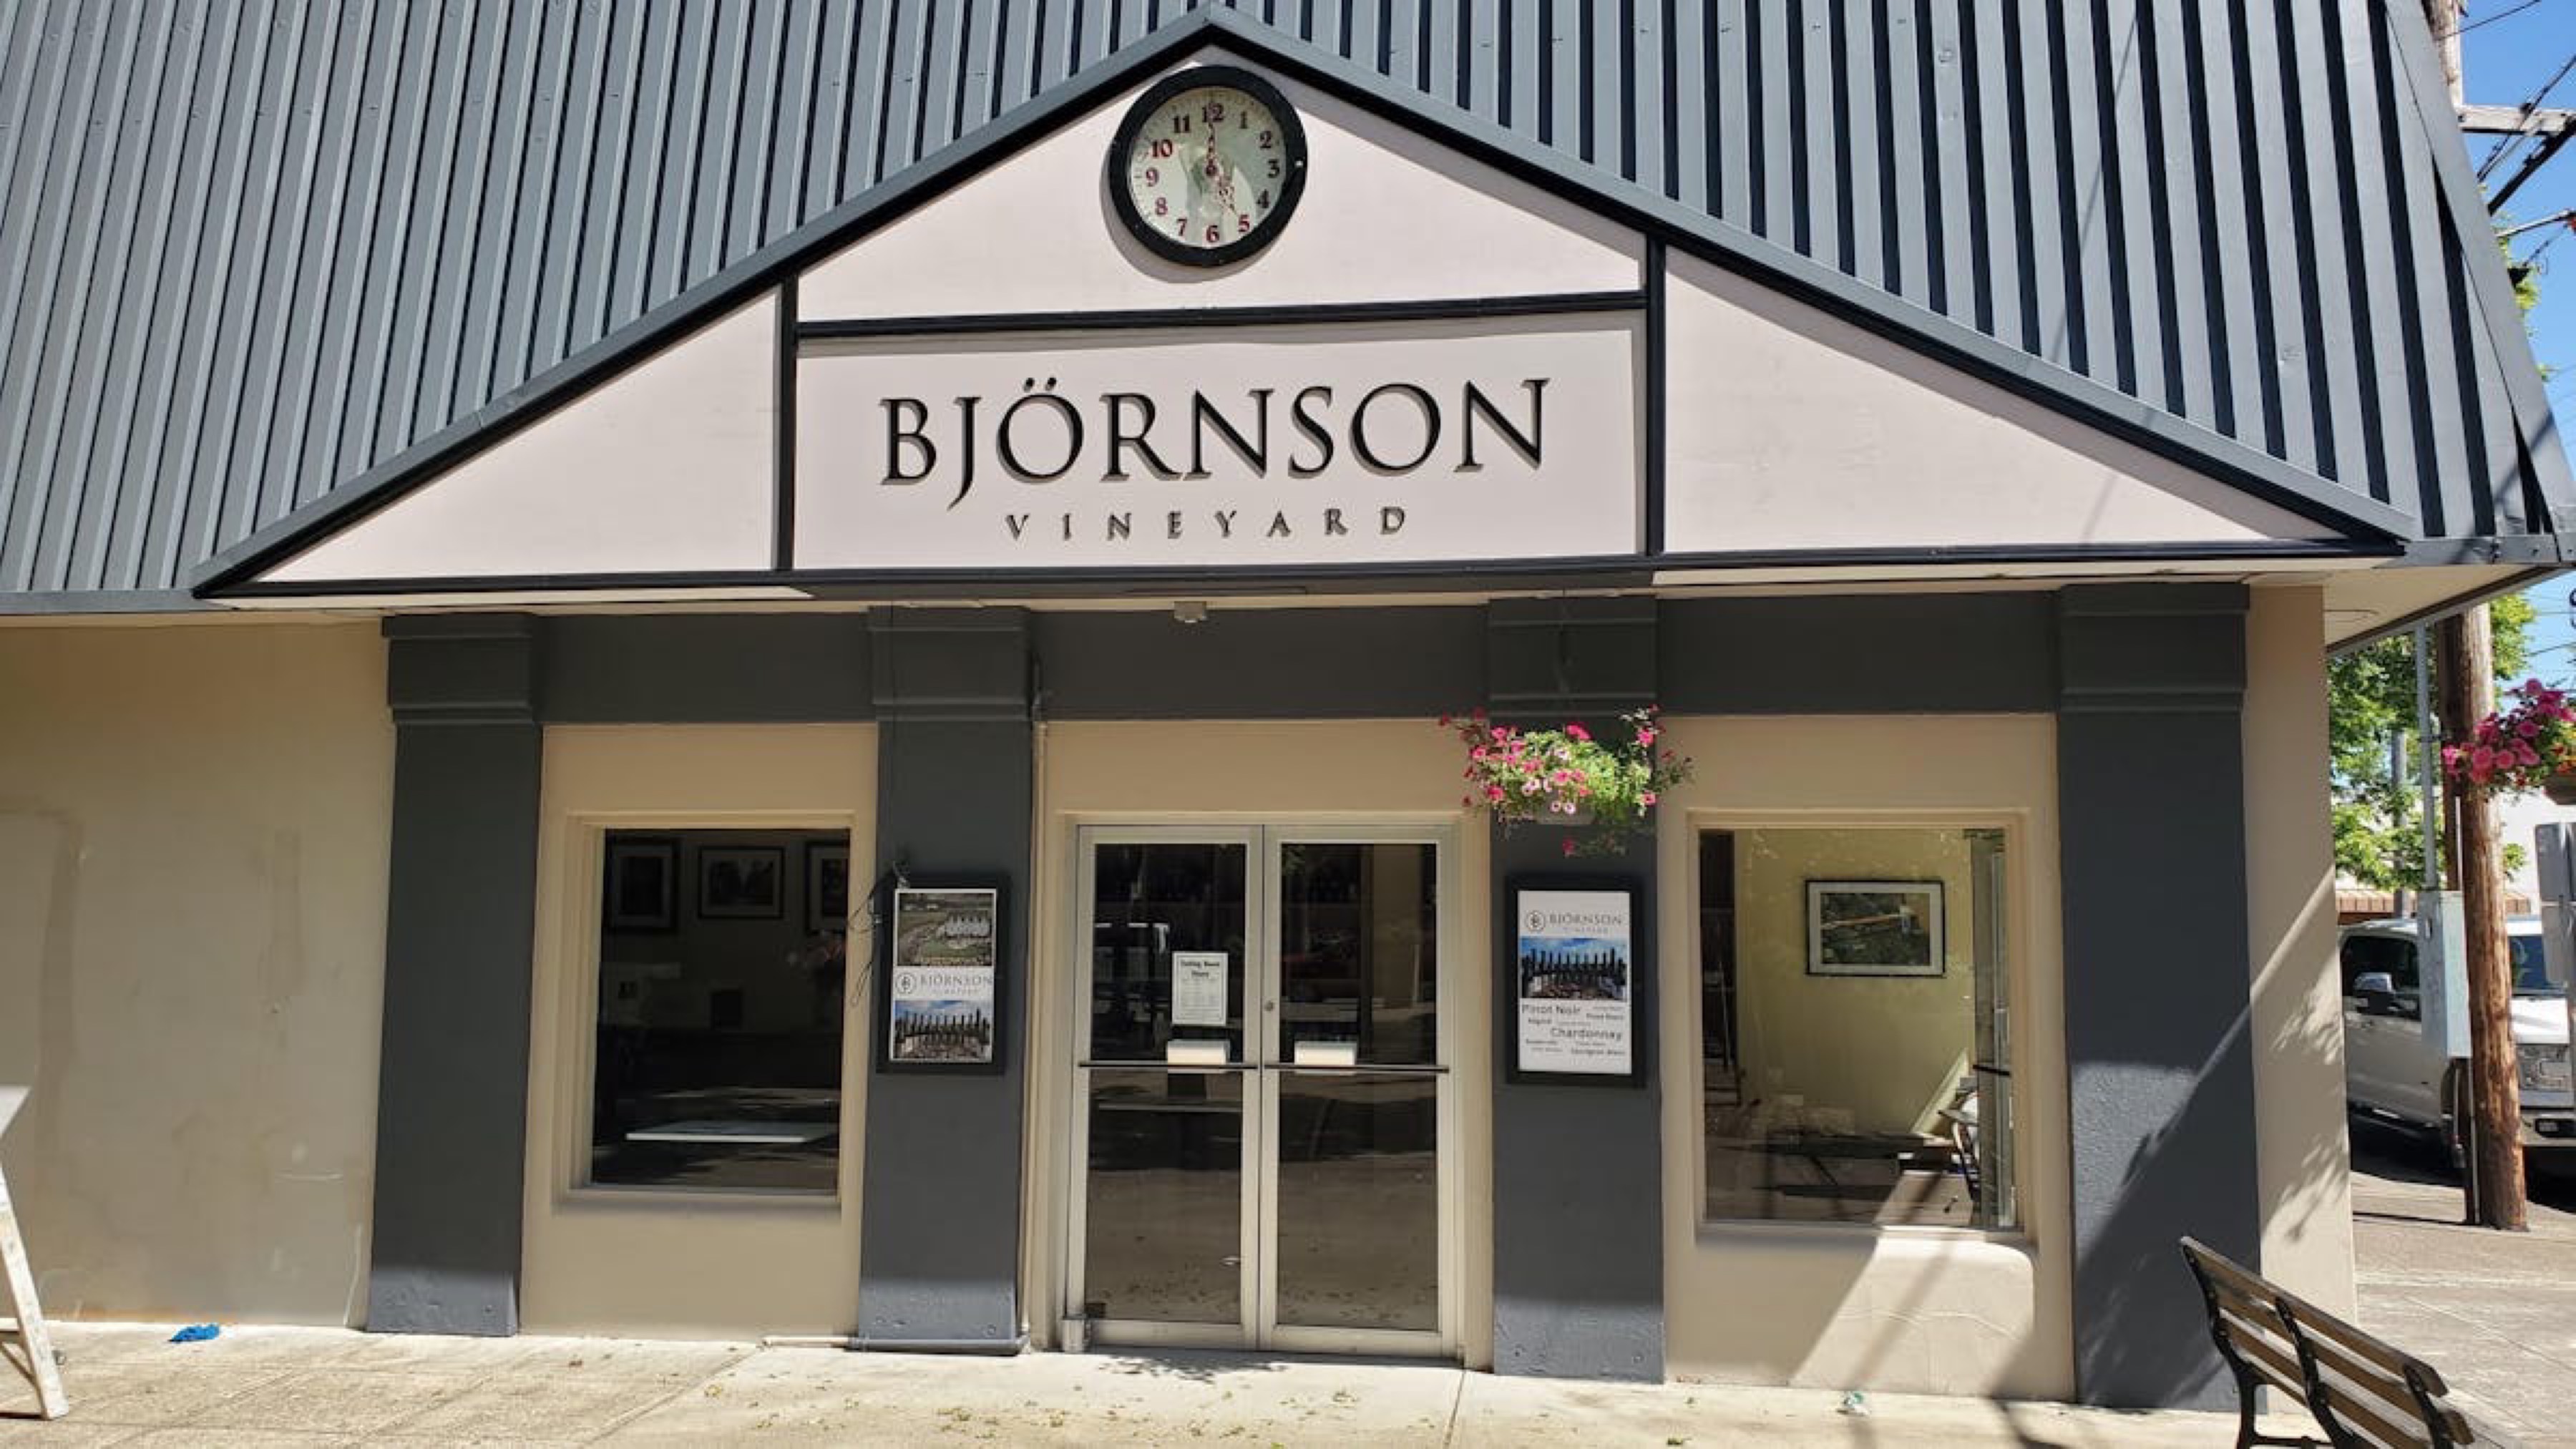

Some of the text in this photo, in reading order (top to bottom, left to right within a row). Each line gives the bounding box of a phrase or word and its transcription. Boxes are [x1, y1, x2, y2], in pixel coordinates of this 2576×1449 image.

[1201, 103, 1224, 122] 12
[1240, 112, 1247, 129] 1
[1174, 115, 1191, 134] 11
[1151, 139, 1173, 157] 10
[1259, 130, 1272, 149] 2
[1146, 167, 1158, 186] 9
[1268, 159, 1279, 178] 3
[1155, 197, 1168, 215] 8
[1257, 189, 1269, 208] 4
[1176, 218, 1187, 236] 7
[1239, 215, 1250, 233] 5
[1206, 225, 1219, 243] 6
[880, 377, 1551, 510] BJÖRNSON
[1005, 506, 1405, 541] VINEYARD
